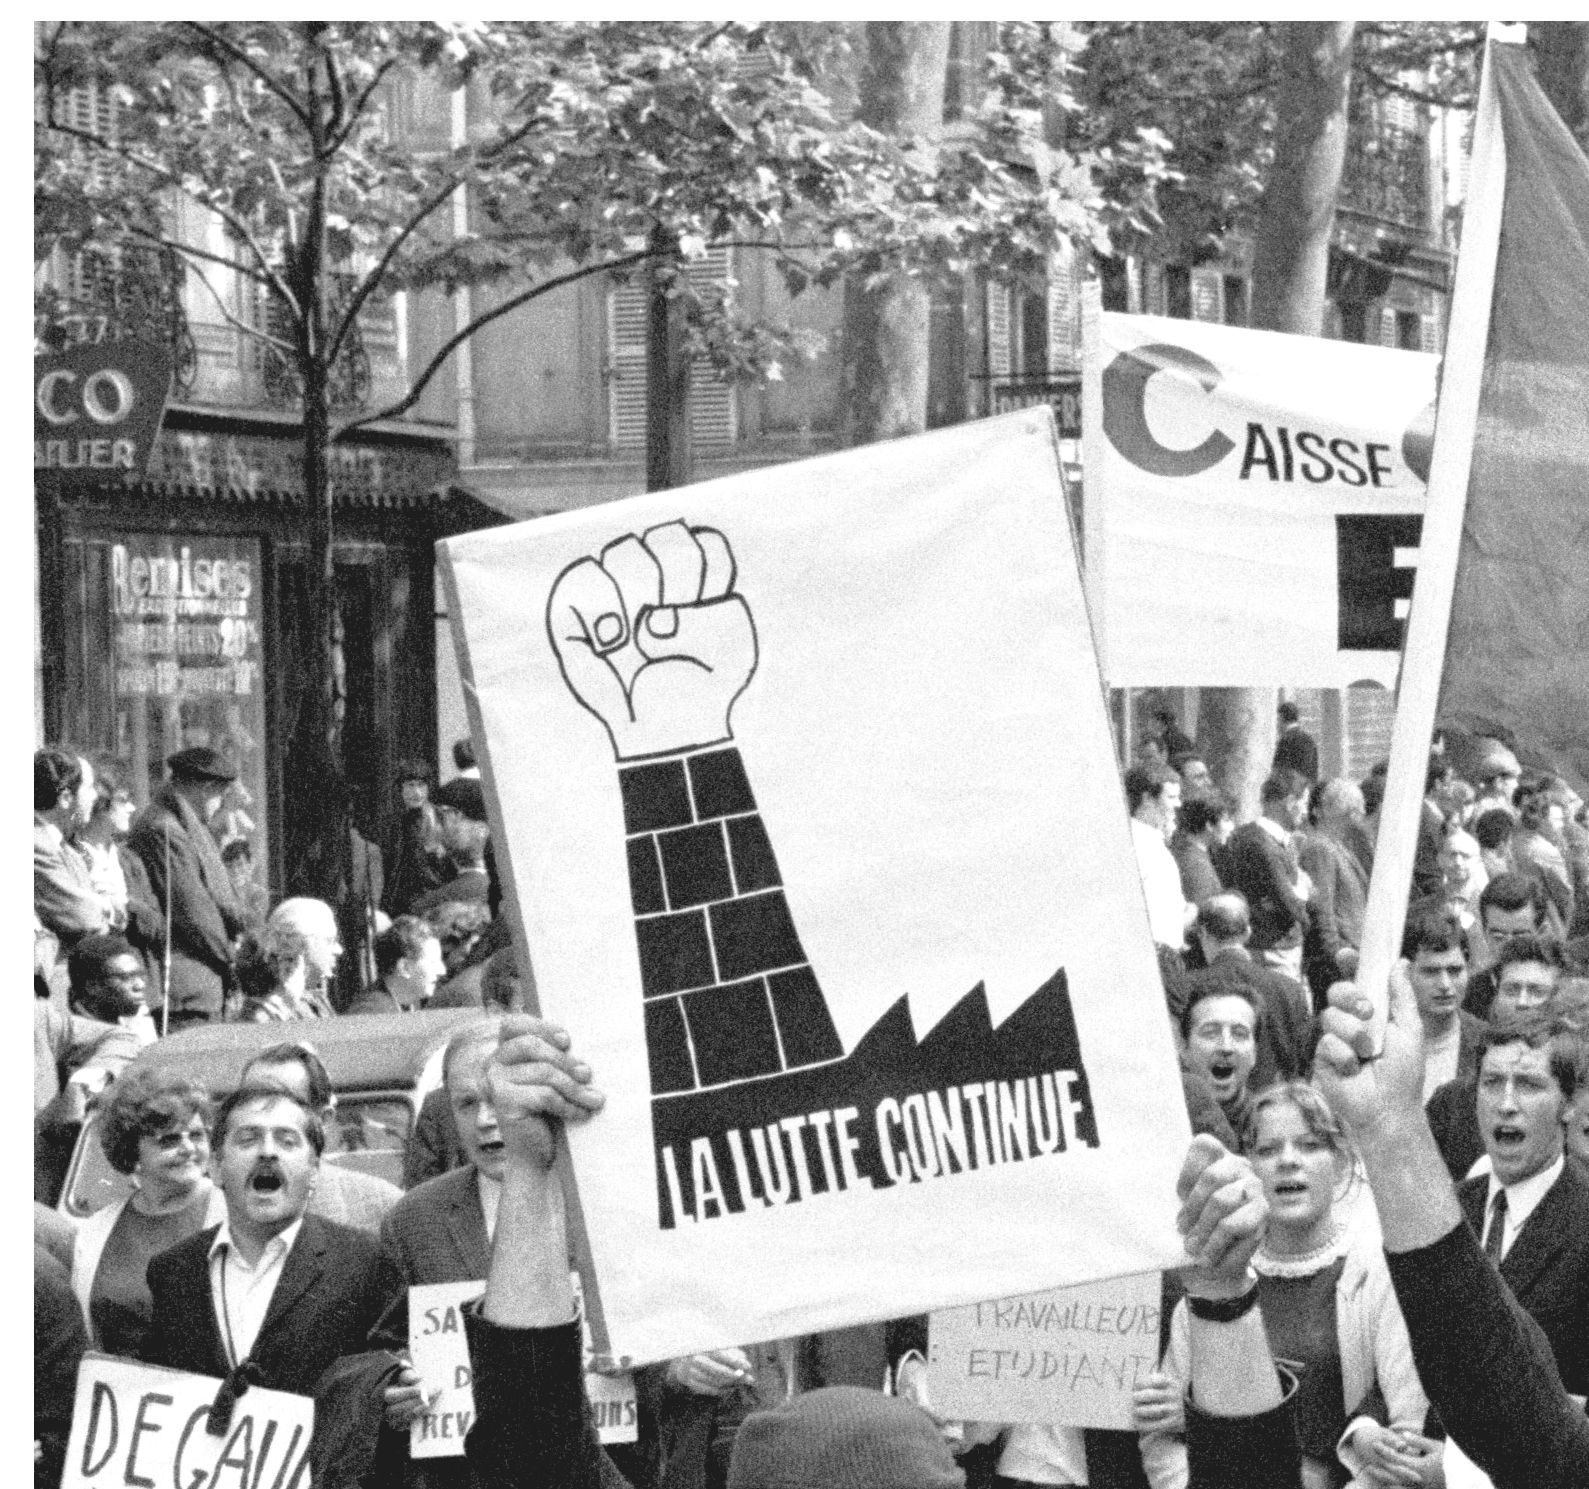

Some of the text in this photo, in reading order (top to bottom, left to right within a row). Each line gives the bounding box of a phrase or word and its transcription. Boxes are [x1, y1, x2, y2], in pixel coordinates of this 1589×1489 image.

[1101, 343, 1399, 488] CAISSE
[662, 1069, 1088, 1225] LA LUTTE CONTINUE
[80, 1380, 174, 1489] DE
